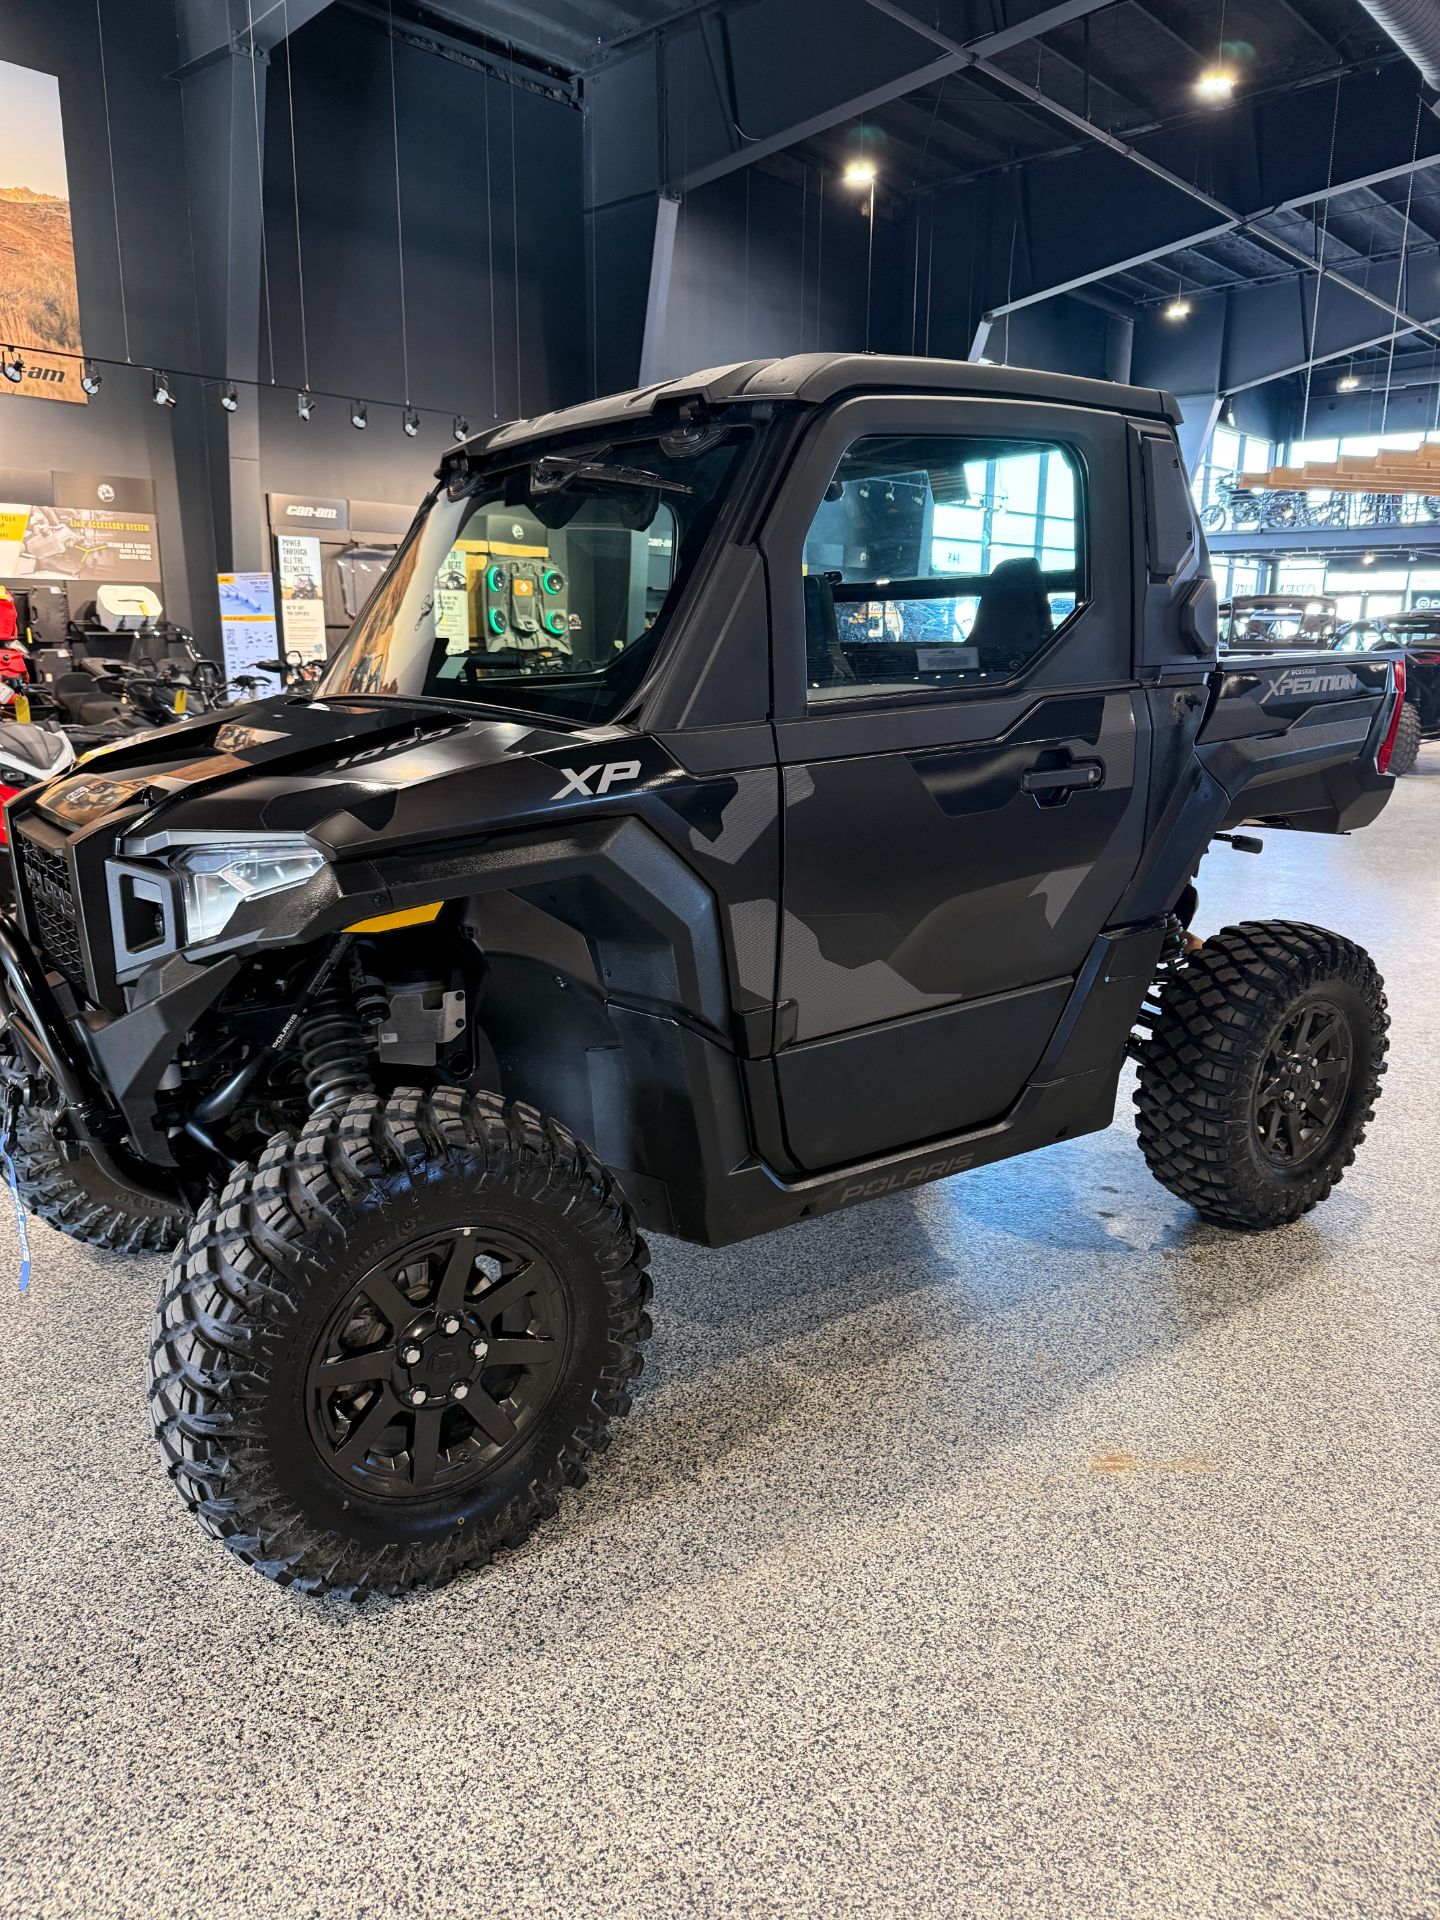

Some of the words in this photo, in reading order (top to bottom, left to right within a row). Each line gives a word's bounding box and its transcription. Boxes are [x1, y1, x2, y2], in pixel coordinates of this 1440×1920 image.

[88, 520, 124, 530] ACCESSORY
[126, 523, 150, 532] SYSTEM
[282, 539, 302, 547] POWER
[282, 547, 307, 556] THROUGH
[283, 556, 293, 564] ALL
[294, 557, 304, 565] THE
[1259, 670, 1357, 704] XPEDITION
[335, 727, 453, 769] 1000
[549, 760, 642, 801] XP
[271, 1013, 298, 1049] POLARIS
[839, 1152, 976, 1204] POLARIS
[11, 1186, 30, 1262] POLARIS
